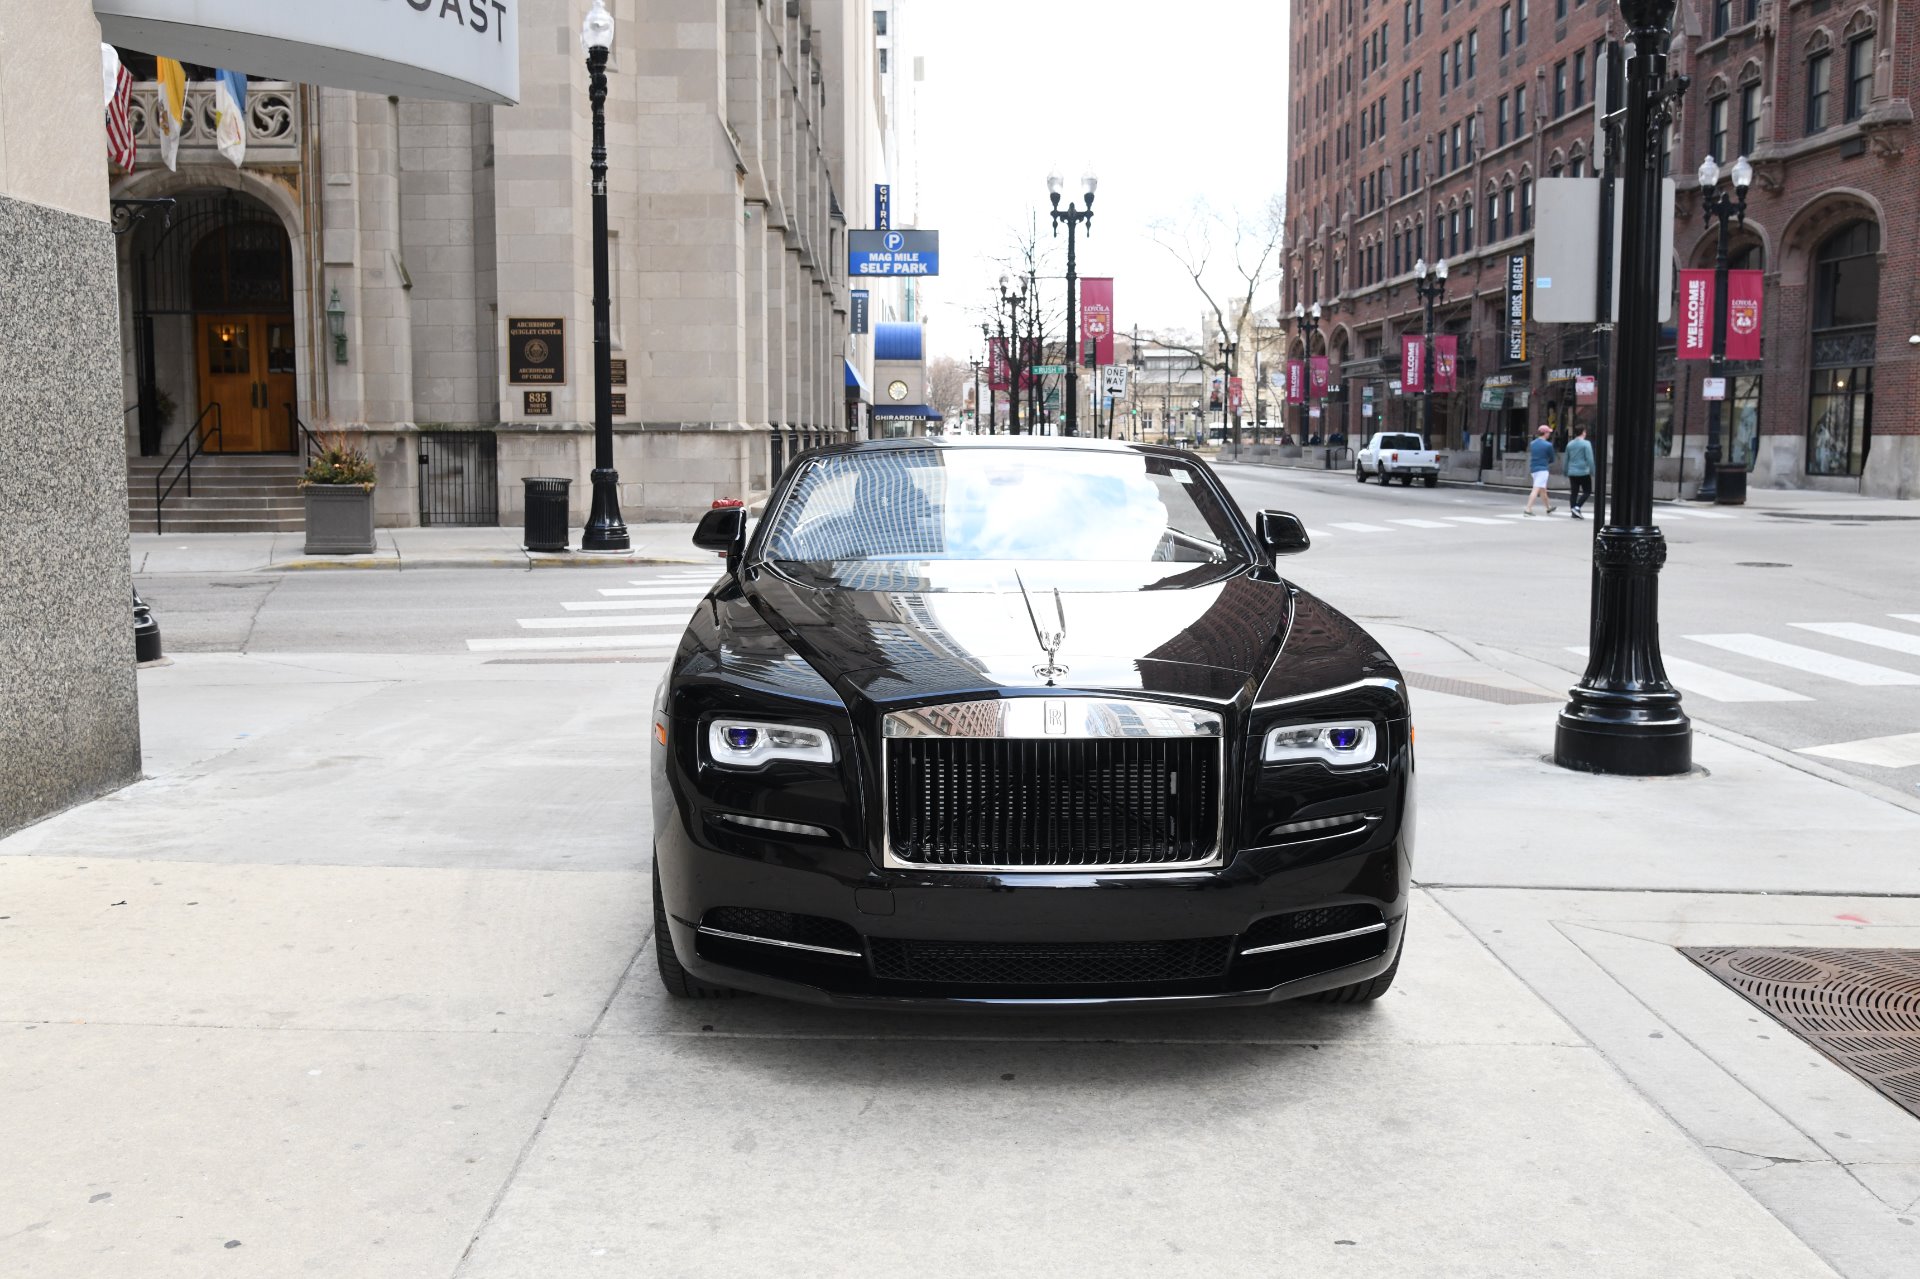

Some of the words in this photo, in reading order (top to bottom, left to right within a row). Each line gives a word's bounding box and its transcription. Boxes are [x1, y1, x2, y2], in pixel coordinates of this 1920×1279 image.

[888, 234, 900, 249] P
[869, 253, 892, 262] MAG
[894, 253, 919, 262] MILE
[860, 262, 891, 274] SELF
[893, 262, 928, 274] PARK
[1512, 257, 1524, 291] BAGELS
[1687, 280, 1699, 348] WELCOME
[1038, 365, 1057, 373] RUSH
[1407, 342, 1415, 386] WELCOME
[1106, 368, 1124, 377] ONE
[1106, 376, 1124, 385] WAY
[529, 393, 547, 403] 835
